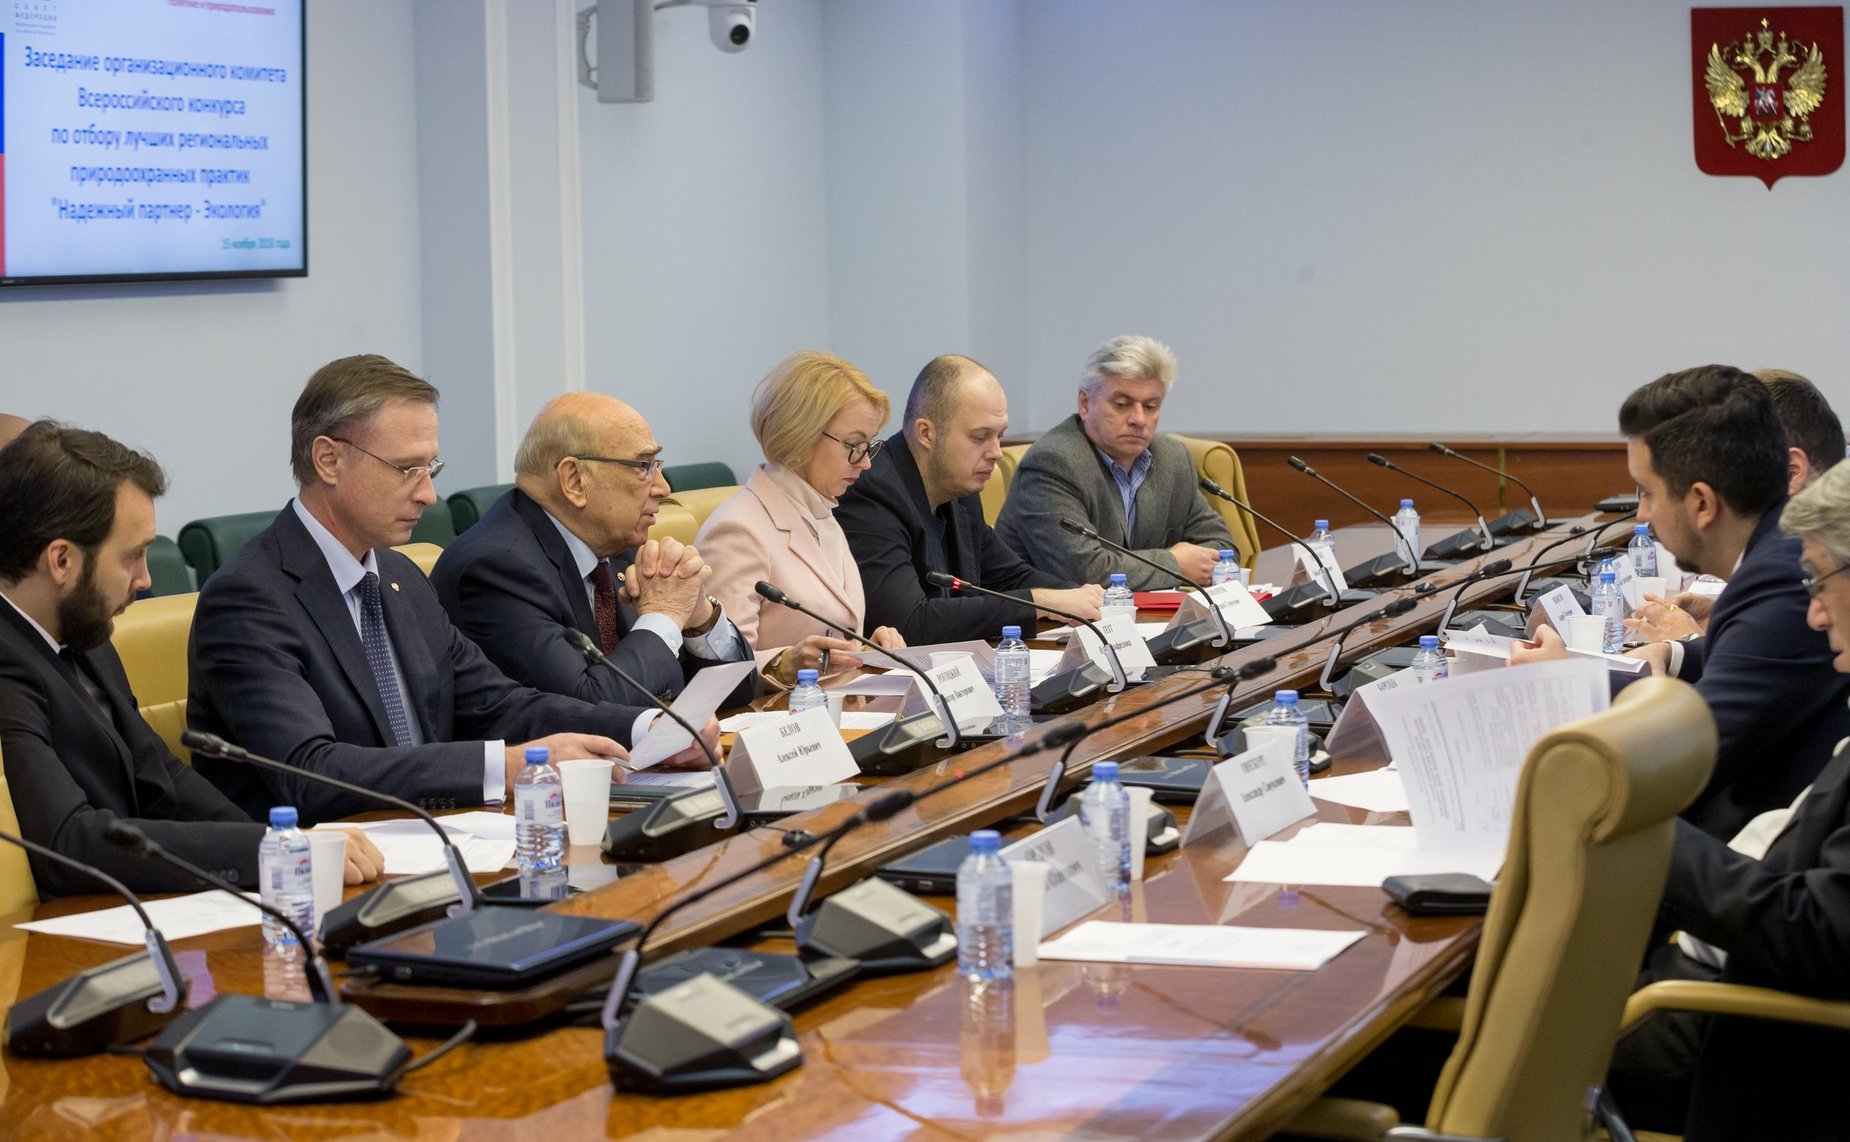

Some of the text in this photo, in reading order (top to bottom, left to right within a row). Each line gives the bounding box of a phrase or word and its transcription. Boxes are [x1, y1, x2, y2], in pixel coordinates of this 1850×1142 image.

[24, 46, 287, 83] Заседание организационного комитета
[78, 87, 246, 119] Всероссийского конкурса
[51, 123, 269, 152] по отбору лучших региональных
[70, 166, 251, 189] природоохранных практик
[138, 203, 192, 225] партнер
[779, 722, 802, 738] БЕЛОВ
[777, 741, 822, 763] Алексей Юрьевич
